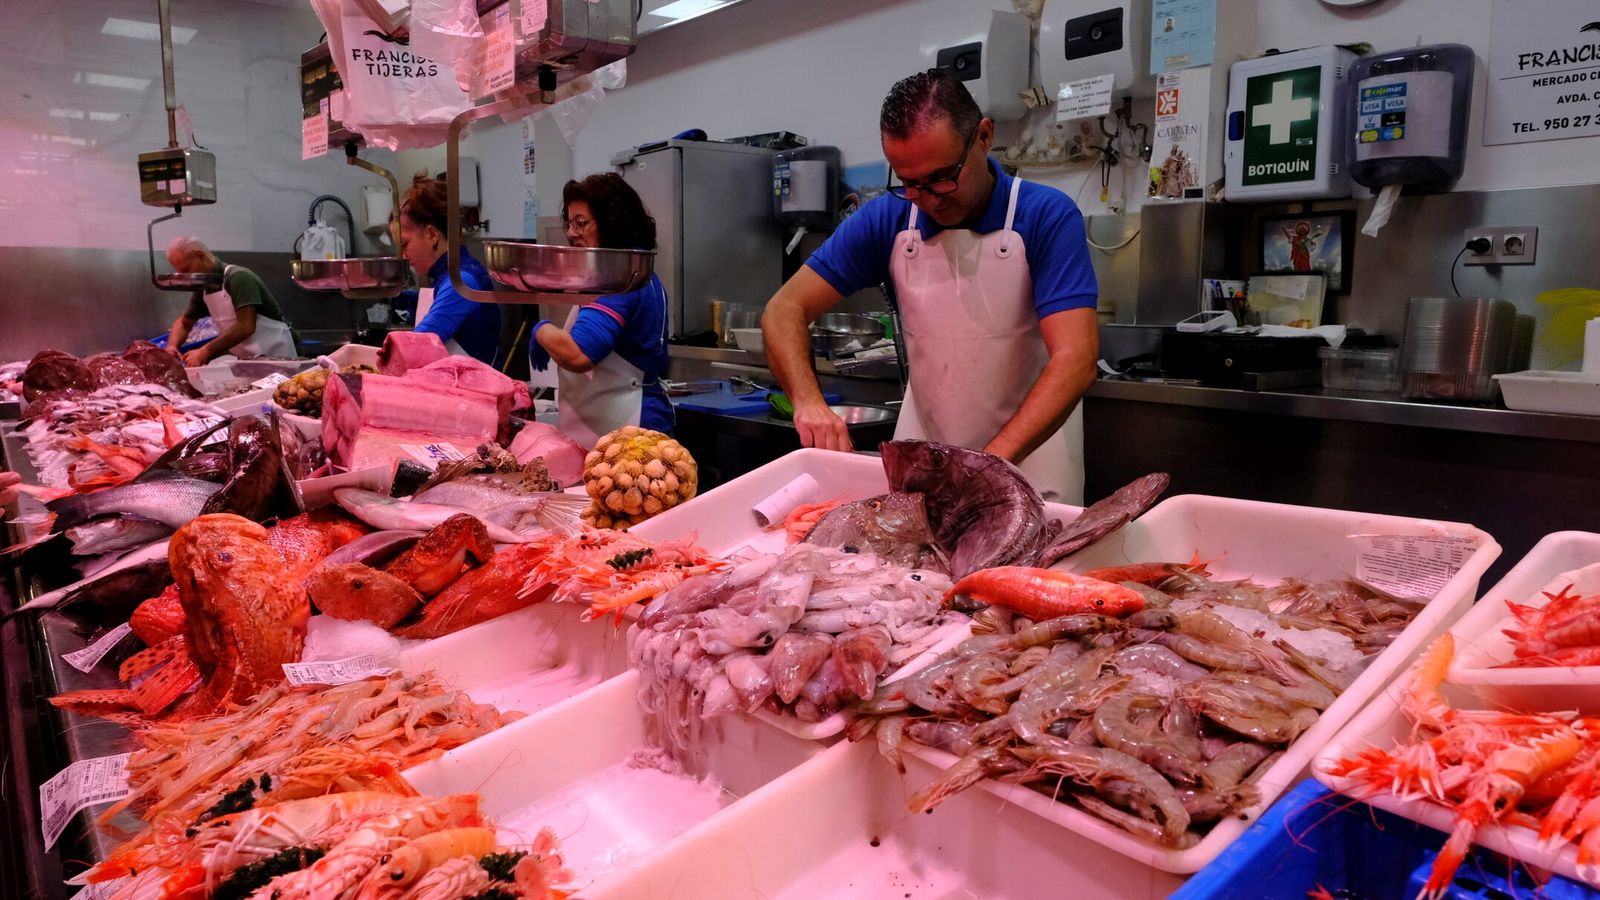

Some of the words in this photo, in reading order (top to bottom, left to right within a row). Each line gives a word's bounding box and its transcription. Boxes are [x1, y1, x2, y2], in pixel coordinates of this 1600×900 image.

[352, 48, 434, 64] FRANCIS
[366, 63, 438, 78] TIJERAS
[1532, 72, 1587, 88] MERCADO
[1364, 102, 1380, 111] VISA
[1387, 99, 1405, 108] VISA
[1556, 93, 1591, 105] AVDA.
[1157, 124, 1198, 138] CARMEN
[1512, 122, 1541, 134] TEL.
[1543, 117, 1570, 131] 950
[1573, 115, 1592, 128] 27
[1247, 158, 1311, 177] BOTIQUÍN
